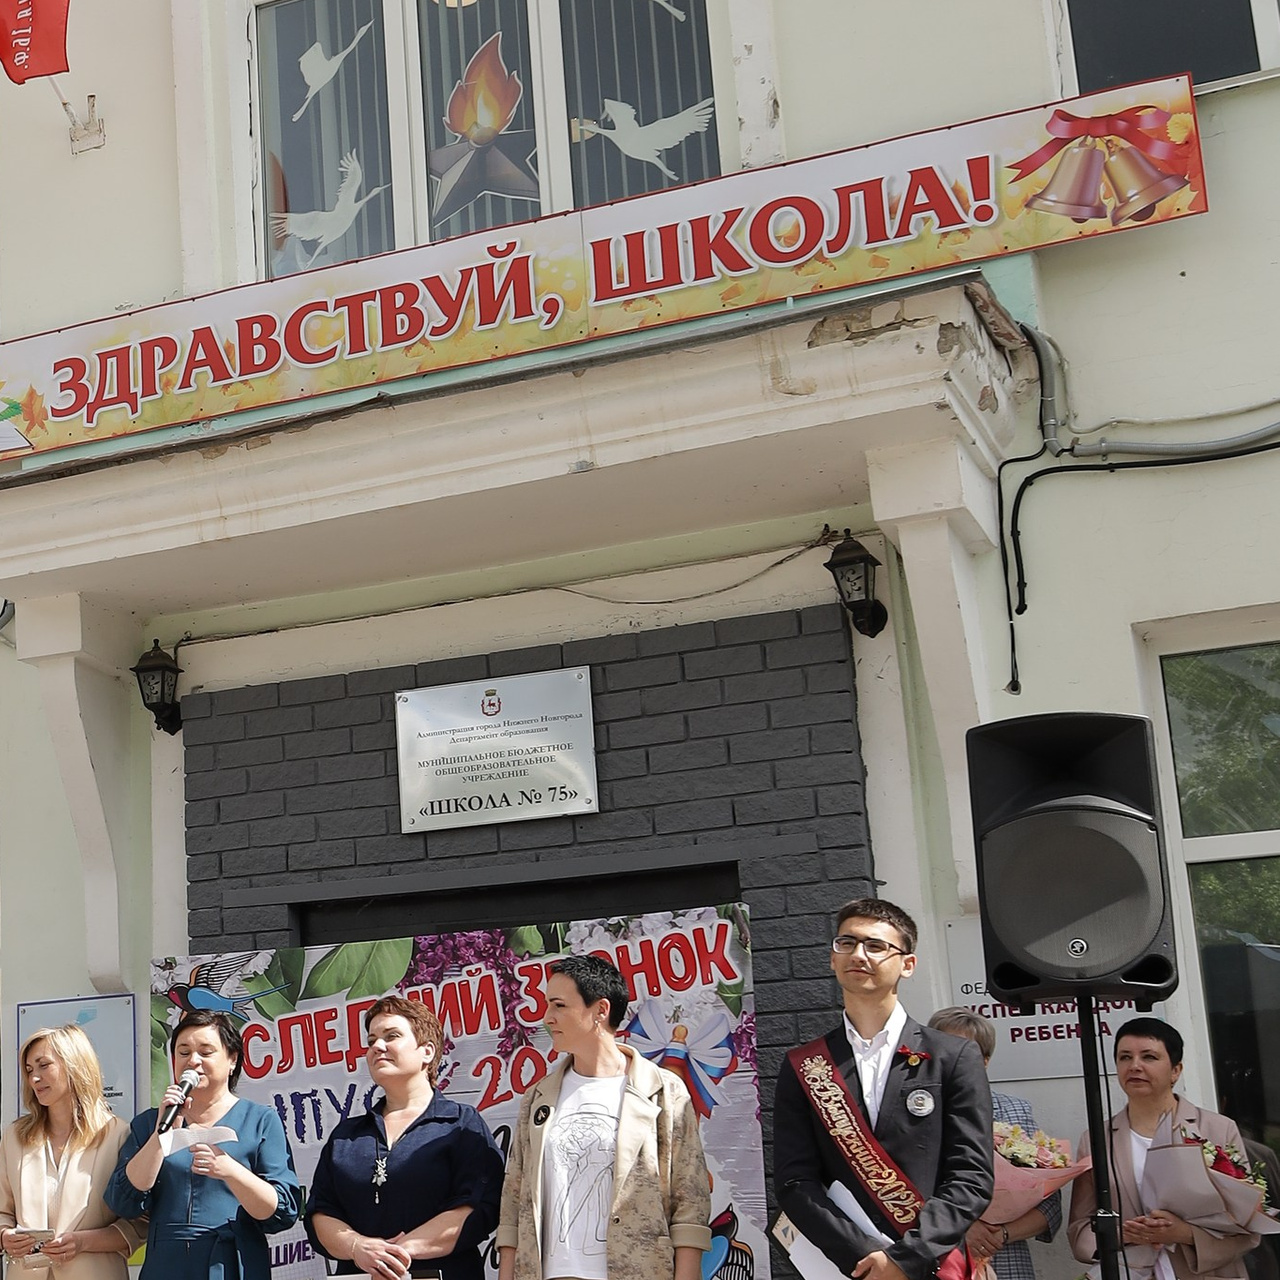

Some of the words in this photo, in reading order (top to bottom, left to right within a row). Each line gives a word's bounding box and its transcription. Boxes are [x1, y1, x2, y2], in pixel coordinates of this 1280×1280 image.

[50, 241, 561, 426] ЗДРАВСТВУЙ,
[590, 154, 999, 303] ШКОЛА!
[416, 724, 475, 739] Администрация
[476, 721, 501, 733] города
[503, 717, 539, 728] Нижнего
[540, 712, 583, 723] Новгорода
[449, 732, 498, 744] Департамент
[499, 726, 549, 738] образования
[418, 751, 506, 768] МУНИЦИПАЛЬНОЕ
[507, 742, 574, 757] БЮДЖЕТНОЕ
[434, 755, 556, 776] ОБЩЕОБРАЗОВАТЕЛЬНОЕ
[462, 769, 529, 783] УЧРЕЖДЕНИЕ
[419, 793, 512, 817] «ШКОЛА
[518, 789, 542, 806] №
[548, 785, 578, 803] 75»
[242, 969, 500, 1080] СЛЕДИЙ
[518, 923, 738, 1023] ЗНОК
[1010, 1021, 1112, 1043] РЕБЕНА
